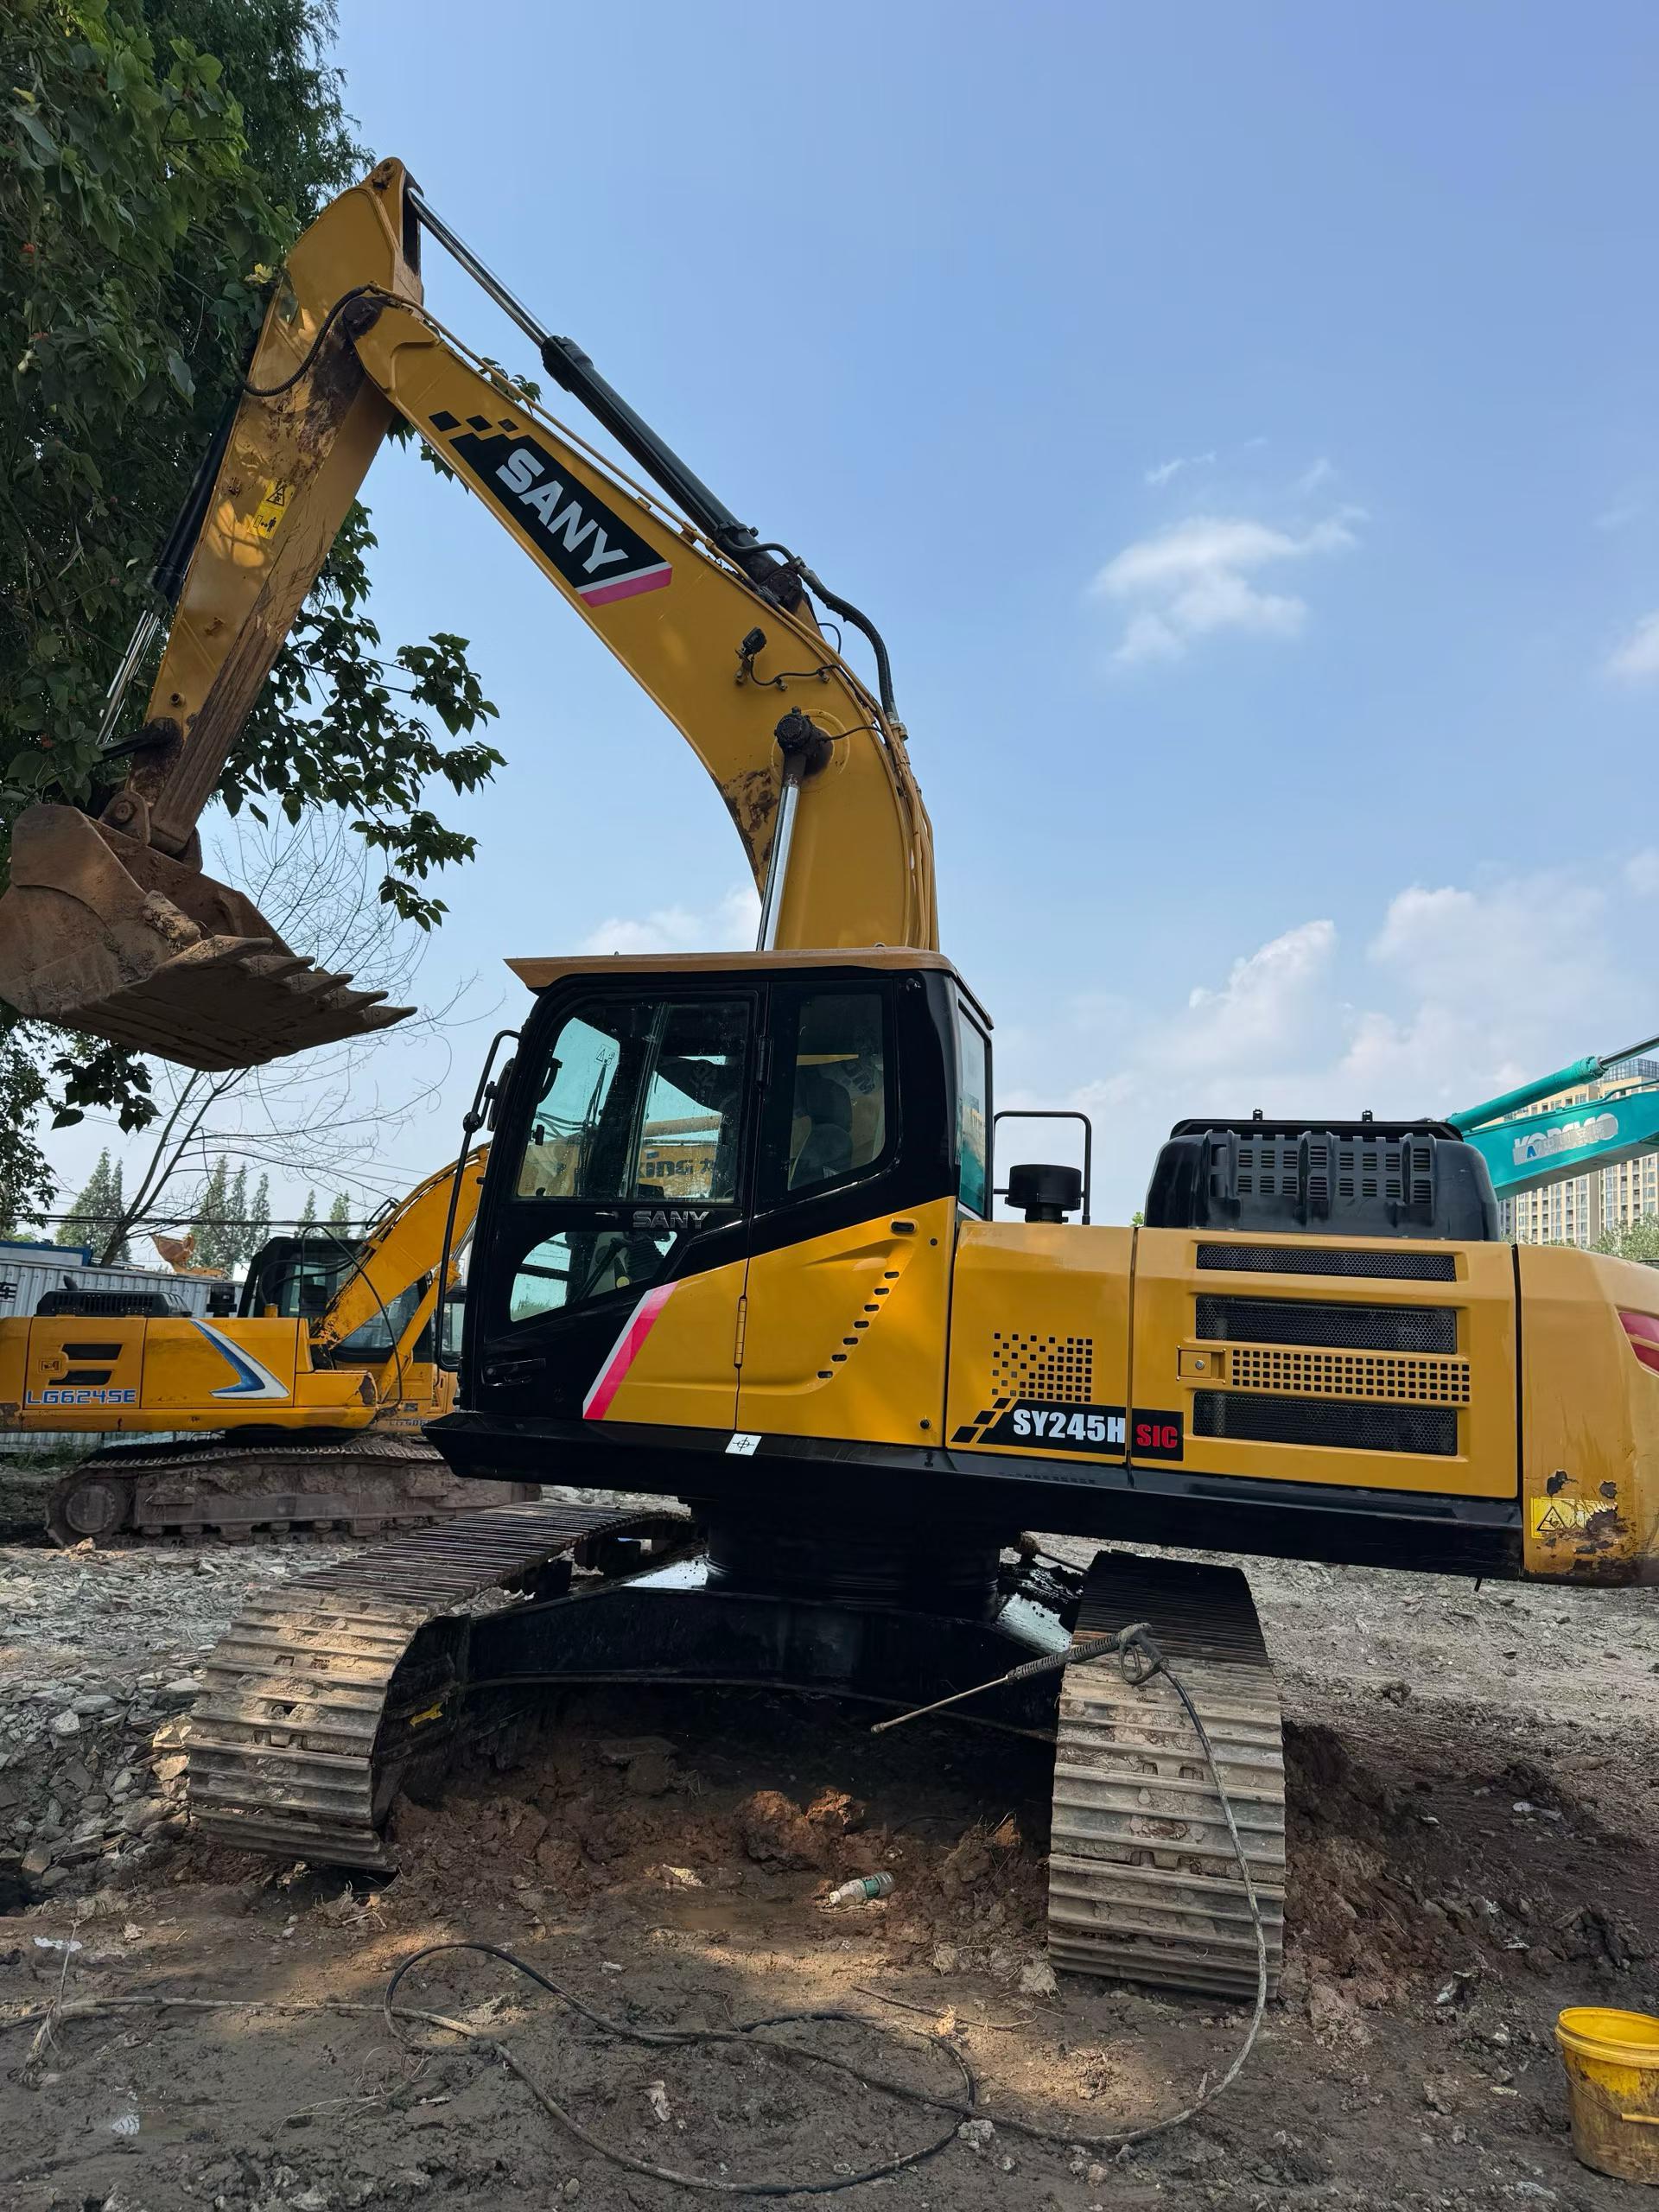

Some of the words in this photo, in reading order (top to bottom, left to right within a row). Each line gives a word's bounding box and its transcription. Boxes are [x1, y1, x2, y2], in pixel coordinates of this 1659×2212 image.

[495, 448, 629, 574] SANY
[632, 1211, 709, 1229] SANY
[1013, 1408, 1126, 1444] SY245H
[1136, 1424, 1178, 1449] SIC
